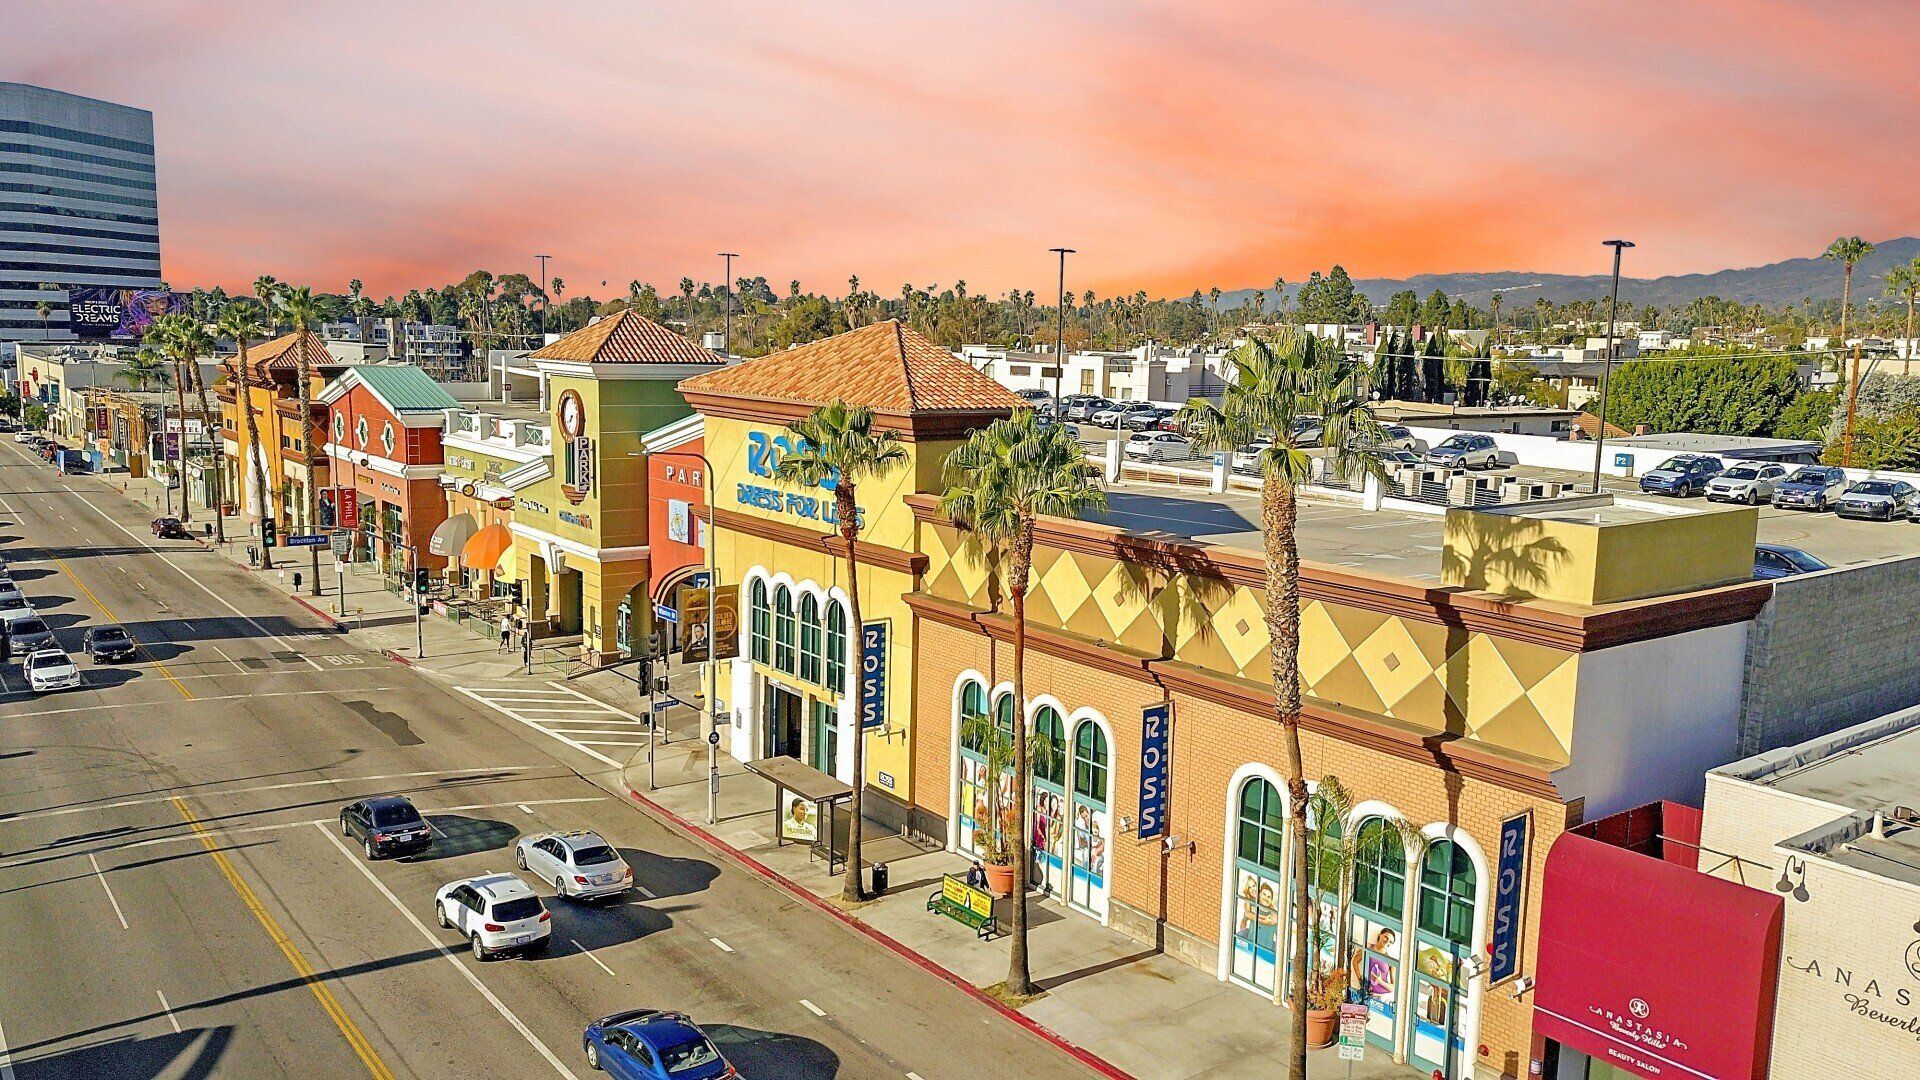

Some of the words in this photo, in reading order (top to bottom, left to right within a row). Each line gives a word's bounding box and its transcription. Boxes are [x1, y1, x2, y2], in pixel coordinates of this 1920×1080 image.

[72, 303, 121, 314] ELECTRIC
[75, 313, 119, 323] DREAMS
[580, 439, 589, 483] PARK
[1214, 454, 1224, 464] P2
[1616, 456, 1626, 465] P2
[344, 489, 352, 500] LA
[737, 483, 784, 512] DRESS
[786, 493, 819, 520] FOR
[822, 500, 865, 530] LES
[345, 501, 353, 519] PHIL
[289, 536, 316, 545] Brockton
[322, 654, 365, 666] BUS
[863, 630, 879, 722] ROSS
[1141, 715, 1160, 830] ROSS
[1494, 829, 1517, 972] ROSS
[1786, 956, 1911, 1006] ANAS
[1589, 1005, 1688, 1050] ANASTASIA
[1609, 1020, 1641, 1042] Beverly
[1641, 1034, 1667, 1049] Hills
[1608, 1048, 1636, 1064] BEAUTY
[1636, 1060, 1661, 1075] SALON
